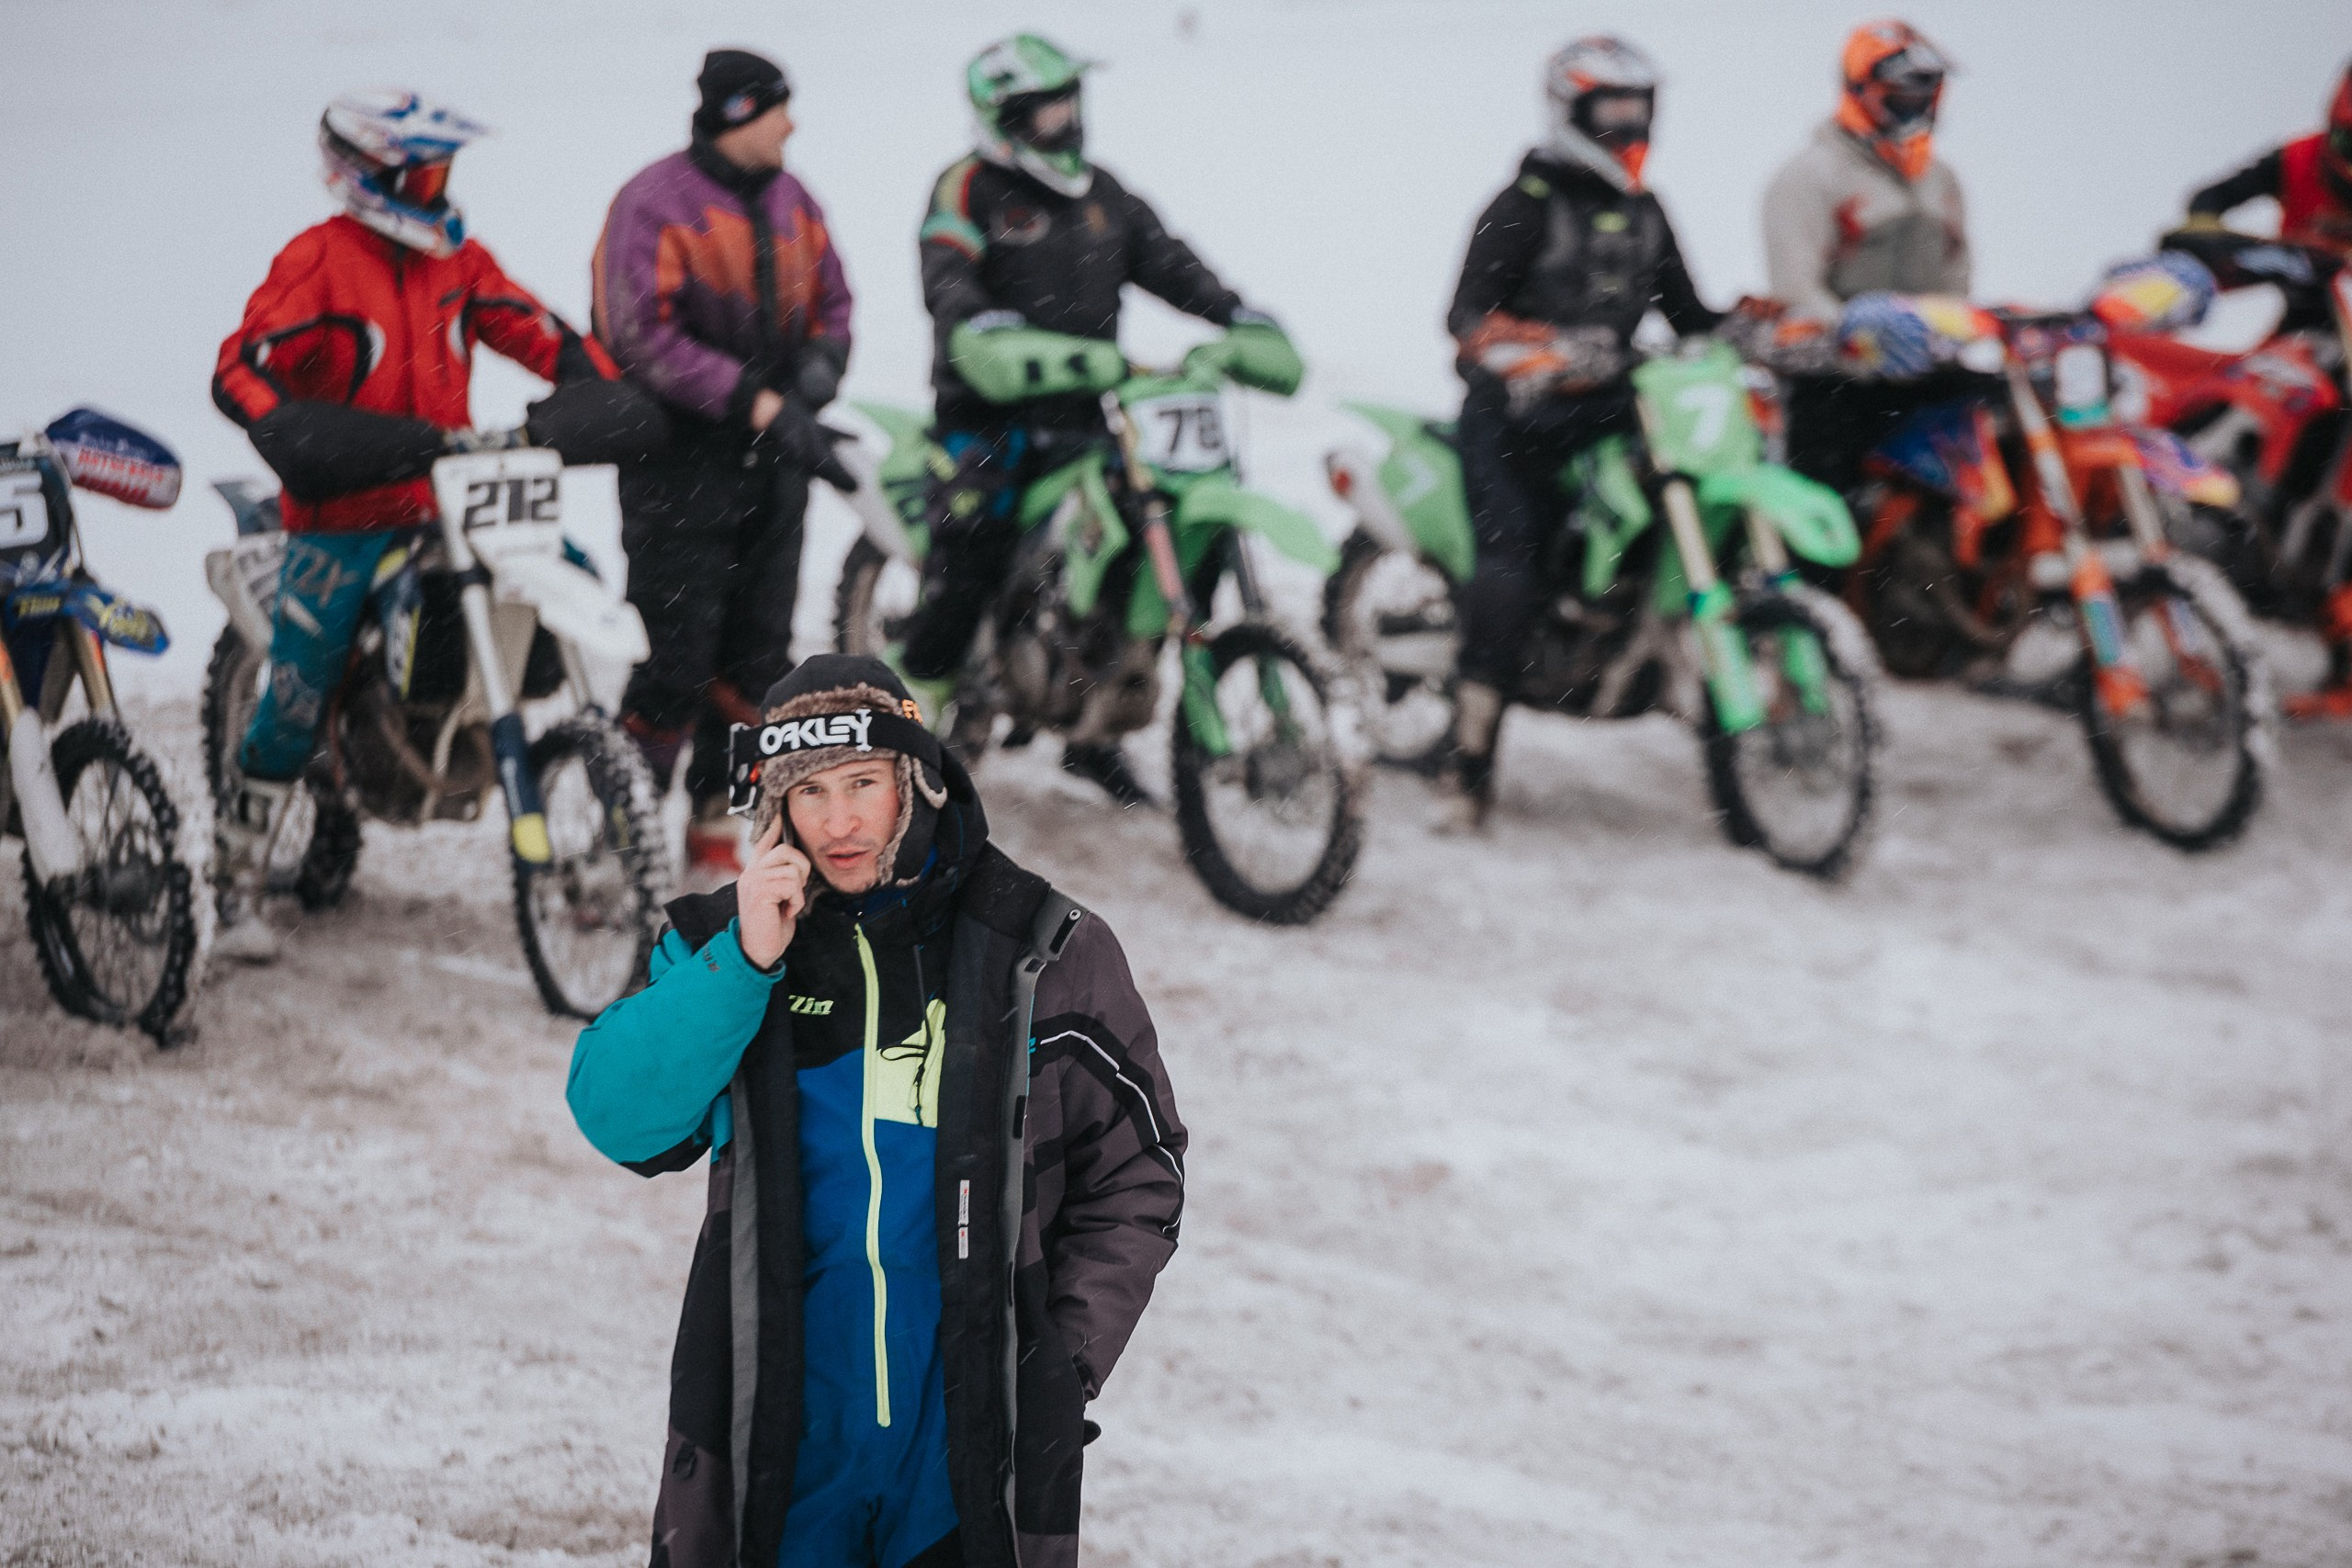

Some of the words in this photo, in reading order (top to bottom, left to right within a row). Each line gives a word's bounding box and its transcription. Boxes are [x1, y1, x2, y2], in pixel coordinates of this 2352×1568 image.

[1677, 383, 1731, 450] 7
[462, 477, 559, 535] 212
[759, 707, 873, 755] OAKLEY
